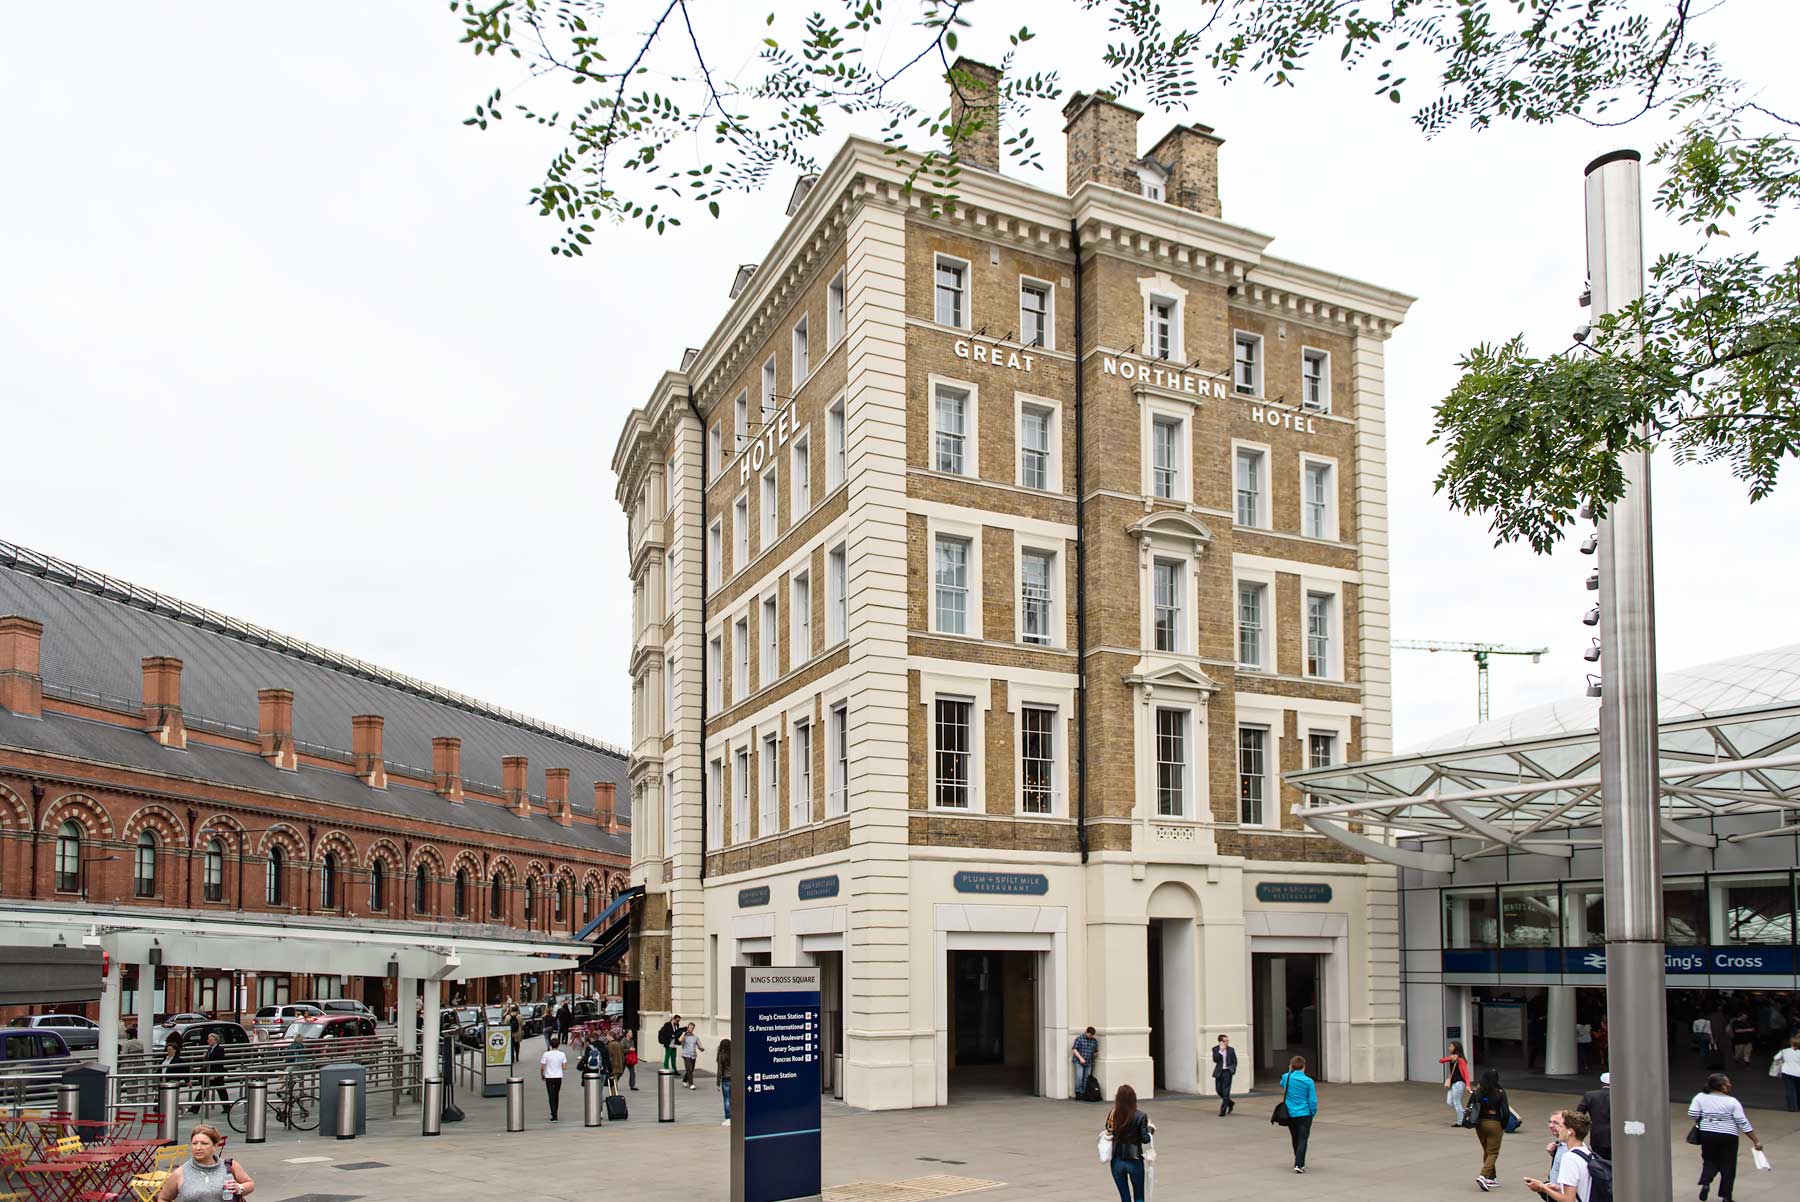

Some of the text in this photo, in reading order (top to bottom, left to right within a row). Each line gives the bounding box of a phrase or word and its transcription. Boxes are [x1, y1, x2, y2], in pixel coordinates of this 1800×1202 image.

[954, 340, 1316, 434] GREAT NORTHERN HOTEL
[740, 402, 801, 487] HOTEL
[962, 875, 984, 883] PLUM
[995, 876, 1018, 884] SPILT
[1715, 954, 1763, 967] Cross
[750, 975, 816, 984] KING'S CROSS SQUARE
[787, 1012, 804, 1020] Station
[774, 1023, 804, 1031] International
[766, 1035, 780, 1043] King's
